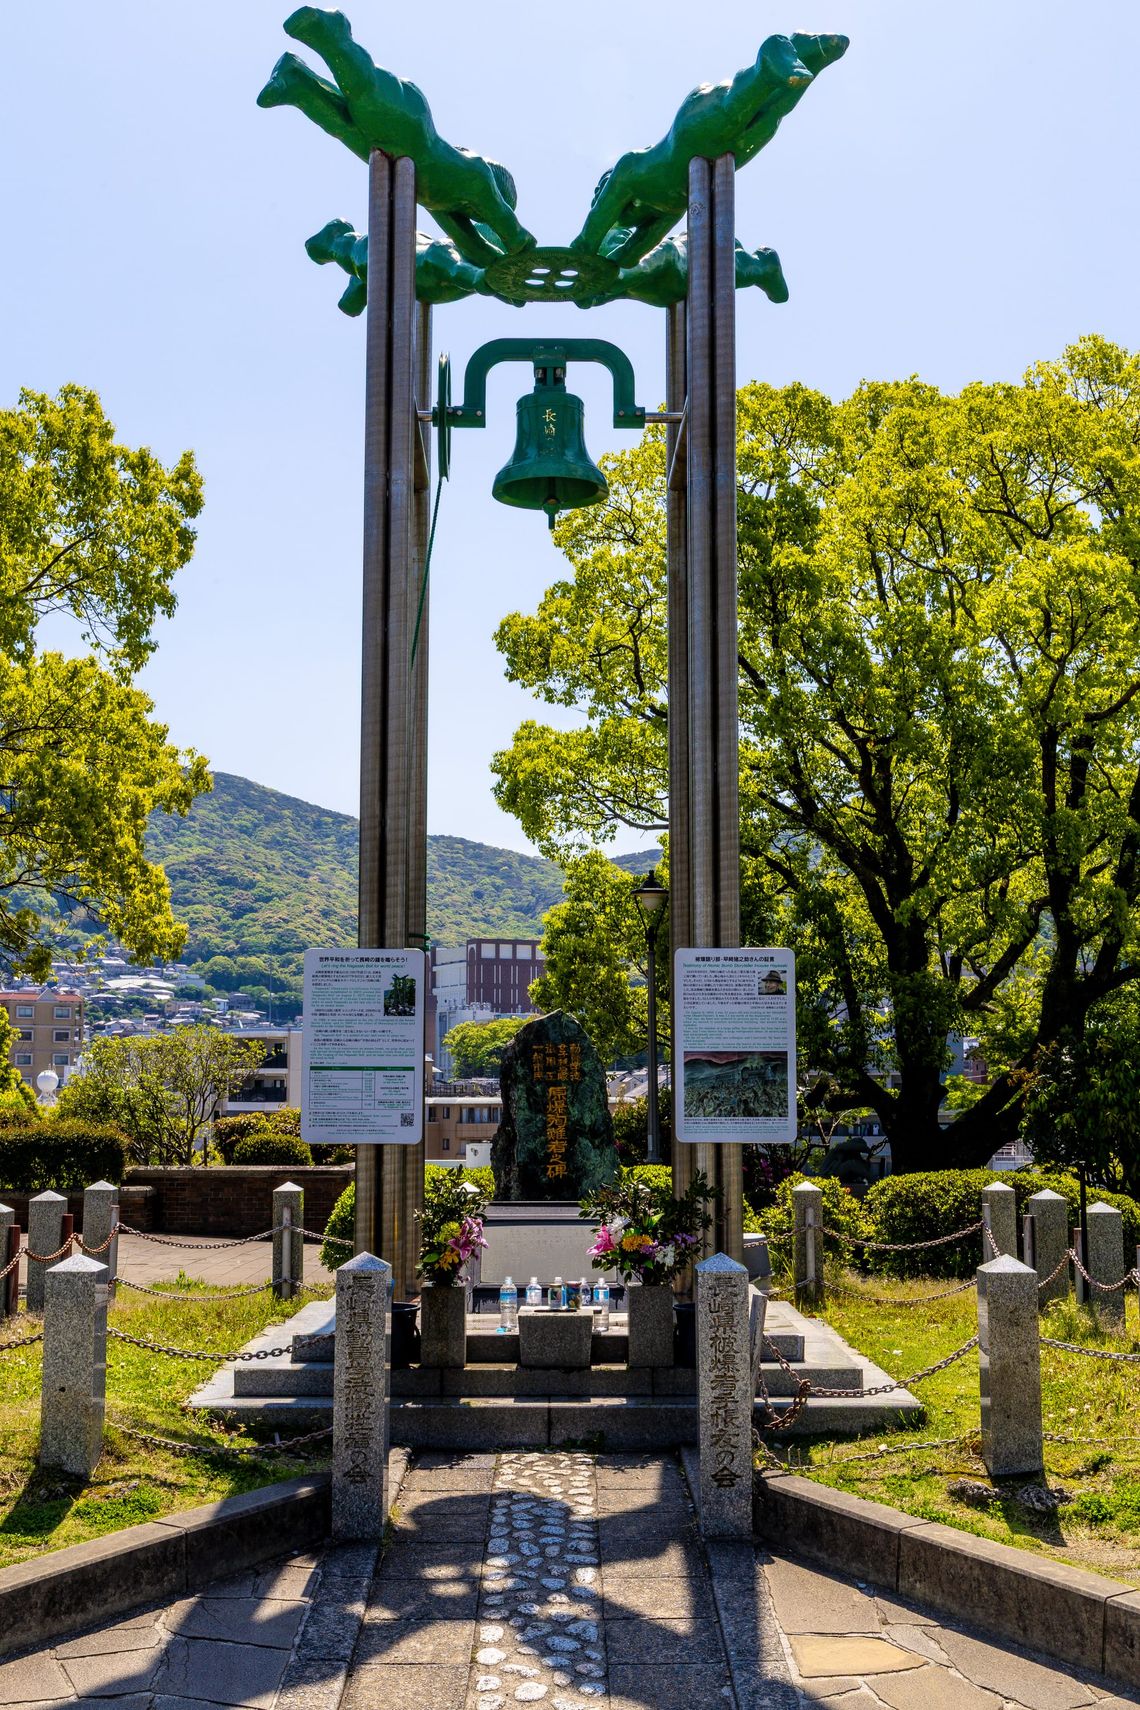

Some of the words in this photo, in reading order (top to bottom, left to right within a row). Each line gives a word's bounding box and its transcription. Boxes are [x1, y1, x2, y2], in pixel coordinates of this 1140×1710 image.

[708, 1275, 742, 1488] 長崎県被爆者手帳友の会
